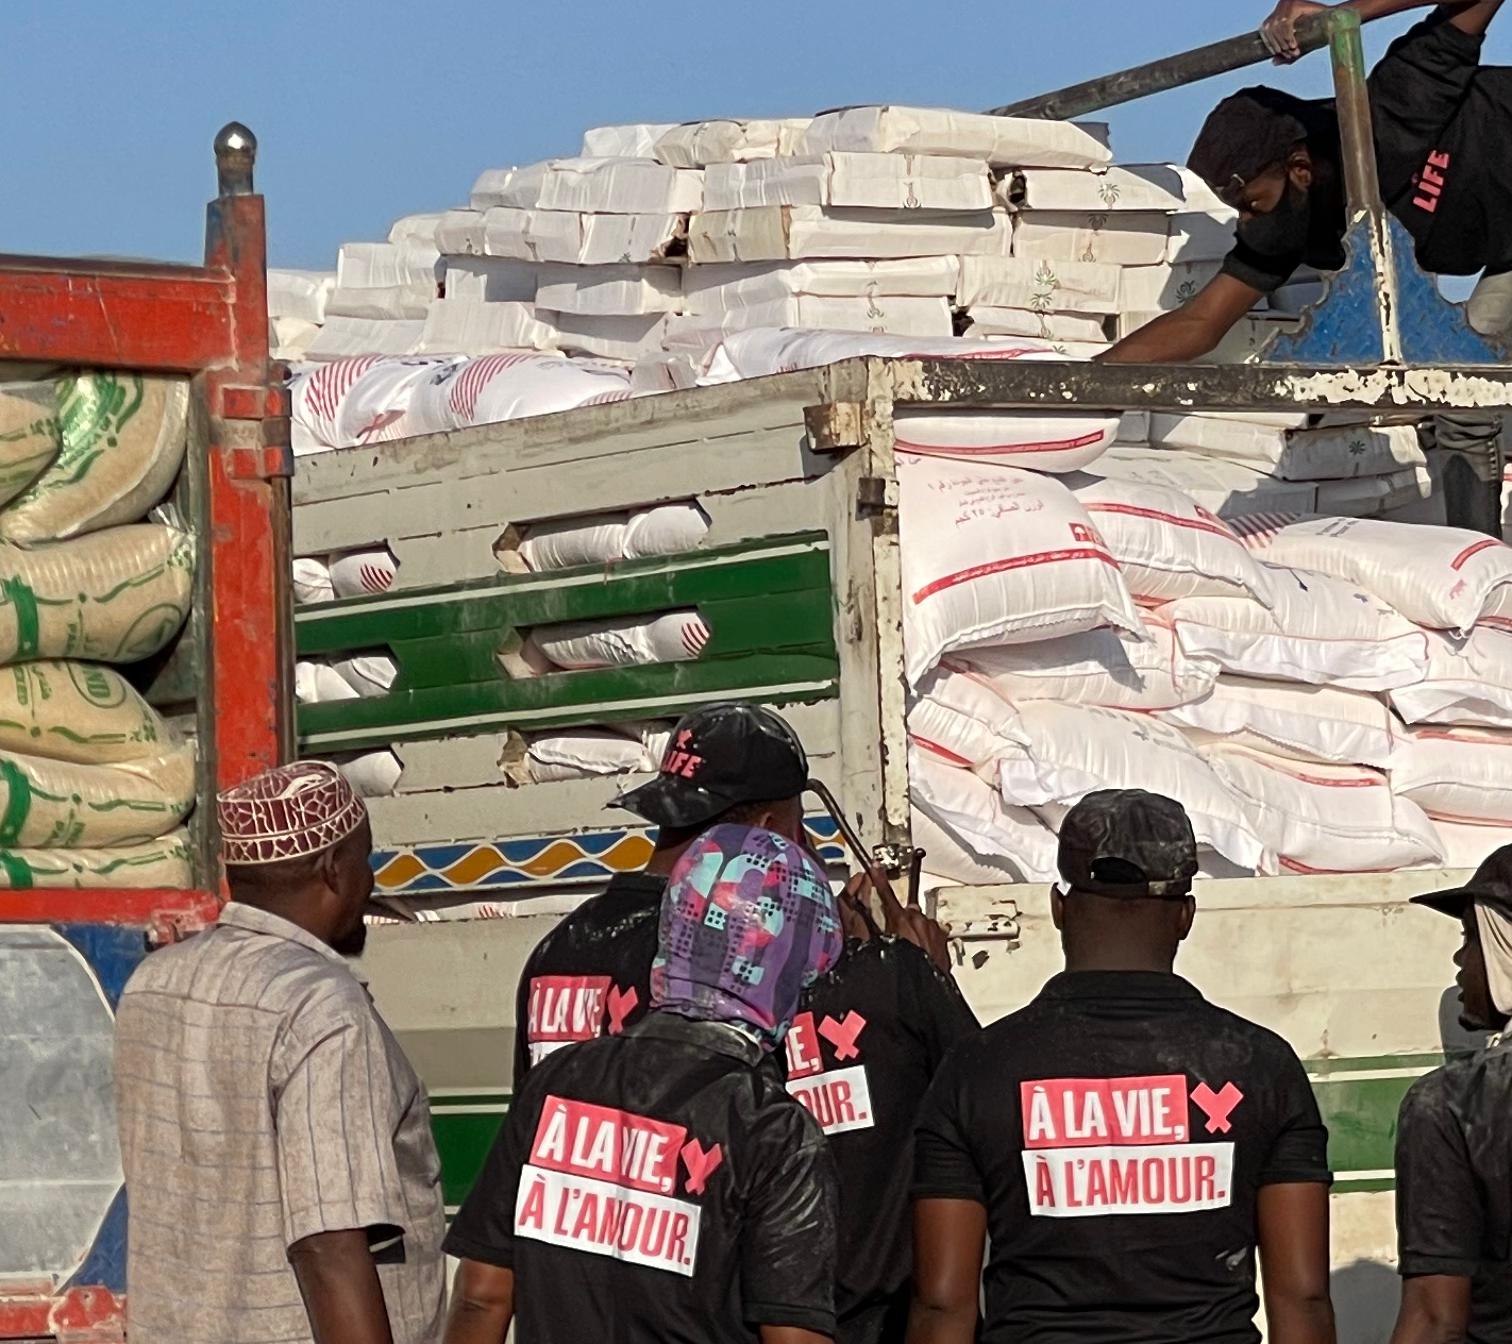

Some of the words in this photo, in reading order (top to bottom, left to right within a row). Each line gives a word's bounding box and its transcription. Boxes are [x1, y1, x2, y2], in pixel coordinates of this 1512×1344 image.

[1413, 150, 1449, 213] LIFE
[541, 987, 571, 1033] LA
[786, 1025, 820, 1072] IE,
[793, 1080, 868, 1127] OUR.
[1029, 1086, 1057, 1141] À
[1063, 1090, 1108, 1139] LA
[1112, 1087, 1185, 1141] VIE,
[536, 1104, 568, 1163] À
[570, 1116, 616, 1173] LA
[621, 1126, 672, 1192] VIE,
[518, 1173, 547, 1230] À
[1036, 1155, 1056, 1208] À
[1064, 1155, 1226, 1208] L'AMOUR.
